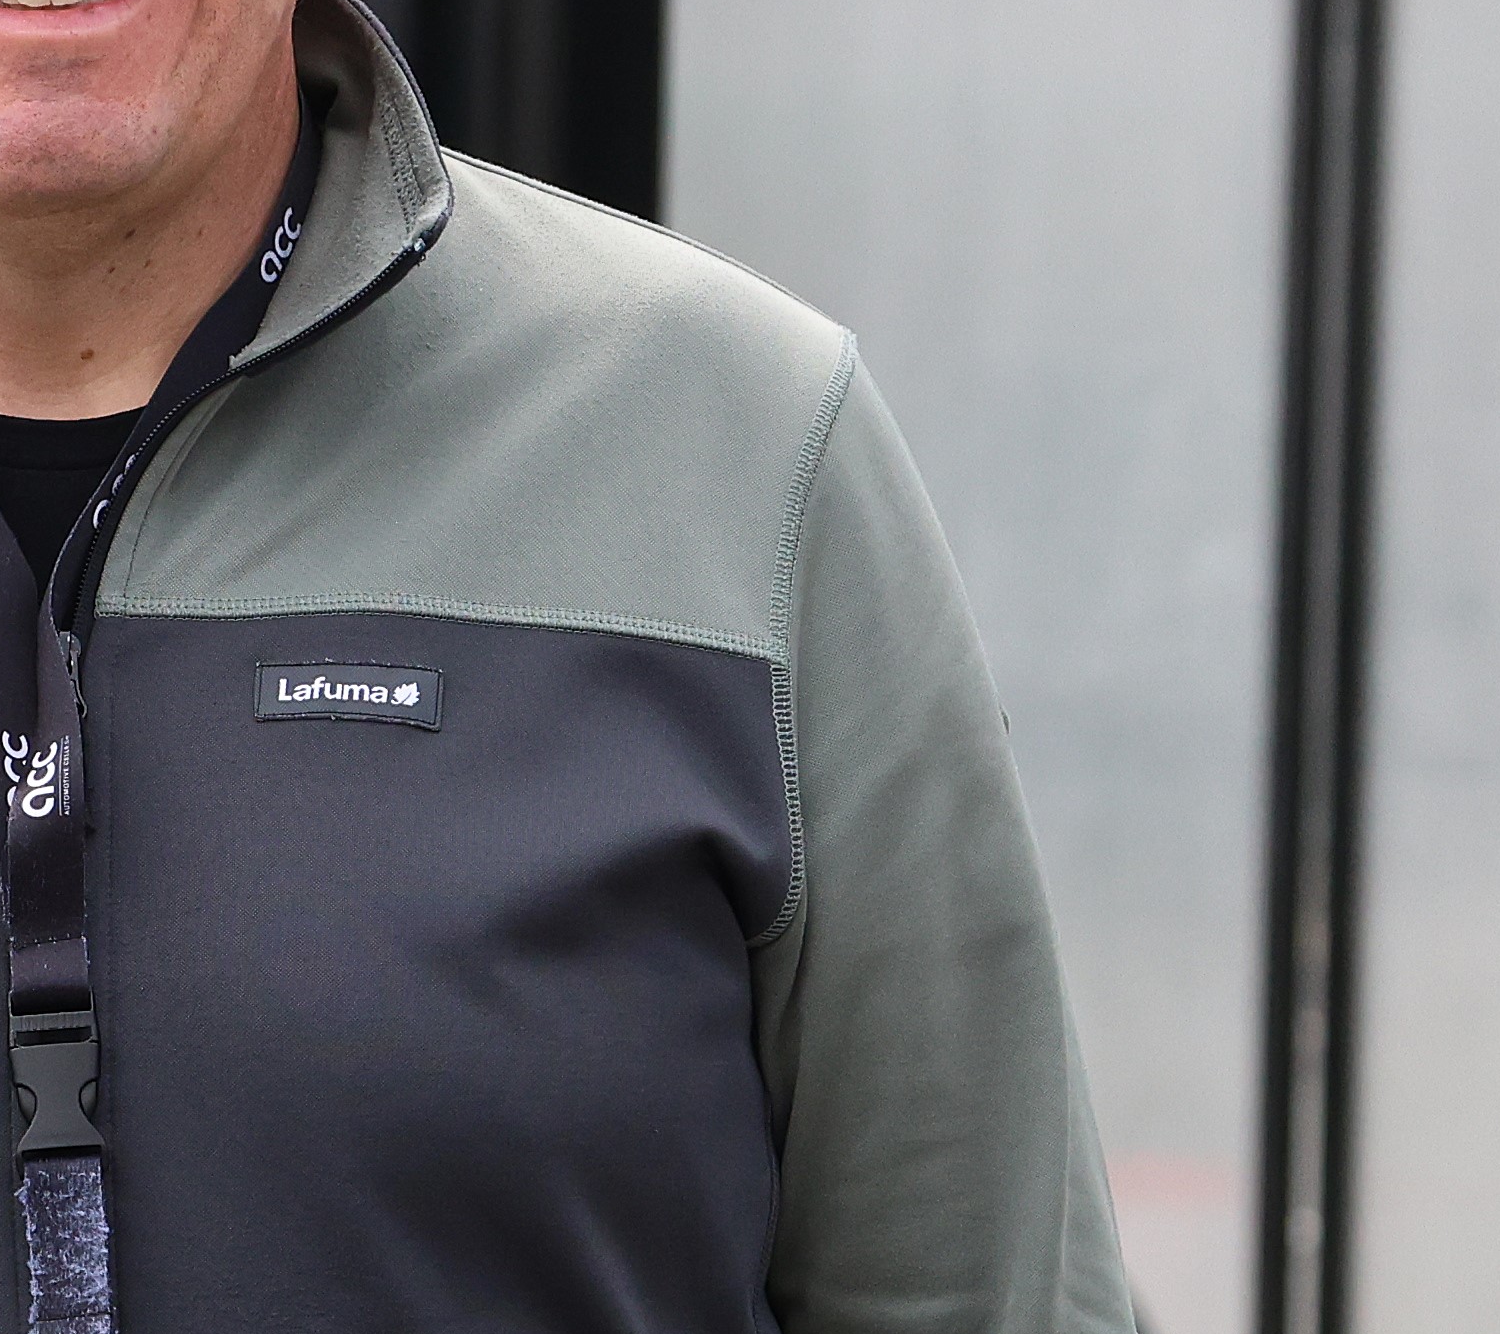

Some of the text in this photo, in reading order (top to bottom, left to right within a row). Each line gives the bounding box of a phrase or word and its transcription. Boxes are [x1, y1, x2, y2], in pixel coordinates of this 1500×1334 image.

[261, 207, 301, 283] acc
[278, 676, 388, 703] Lafuma
[2, 731, 28, 806] cc
[22, 742, 58, 817] acc
[62, 768, 71, 816] AUTOMOTIVE
